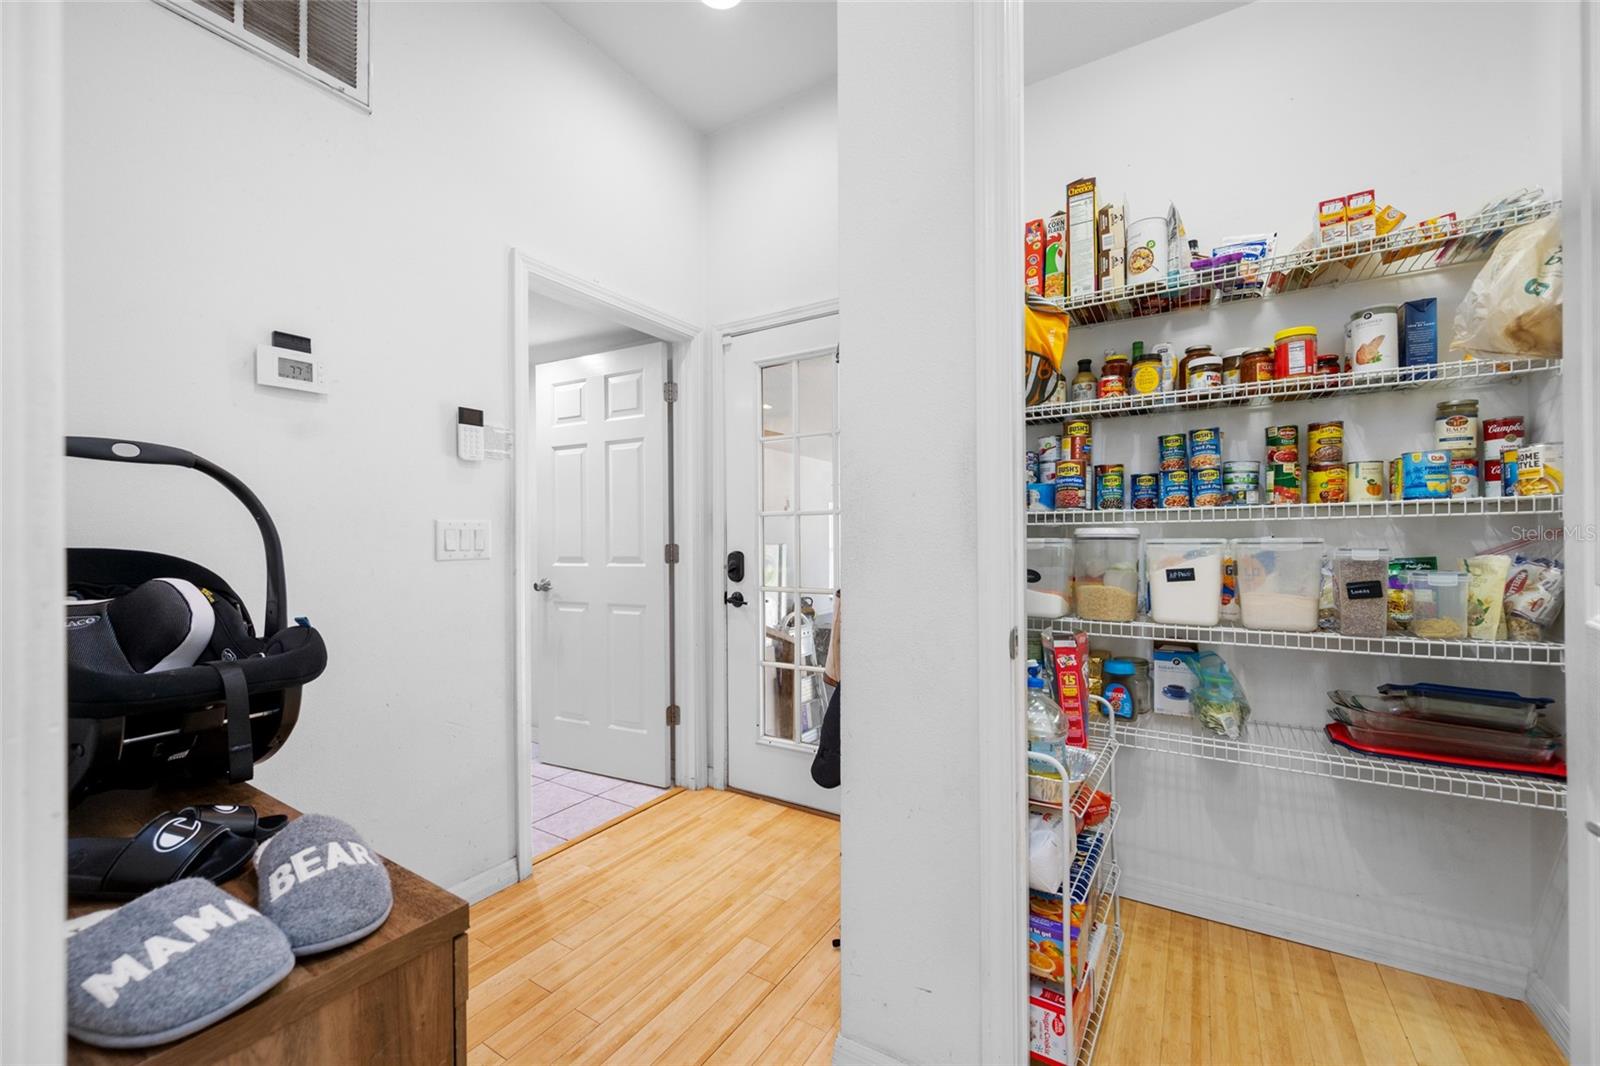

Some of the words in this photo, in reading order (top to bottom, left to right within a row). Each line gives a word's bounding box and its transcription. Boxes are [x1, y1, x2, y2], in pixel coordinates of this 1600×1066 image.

[1057, 465, 1080, 474] BUSH'S
[1063, 675, 1076, 685] 15
[269, 841, 379, 902] BEAR
